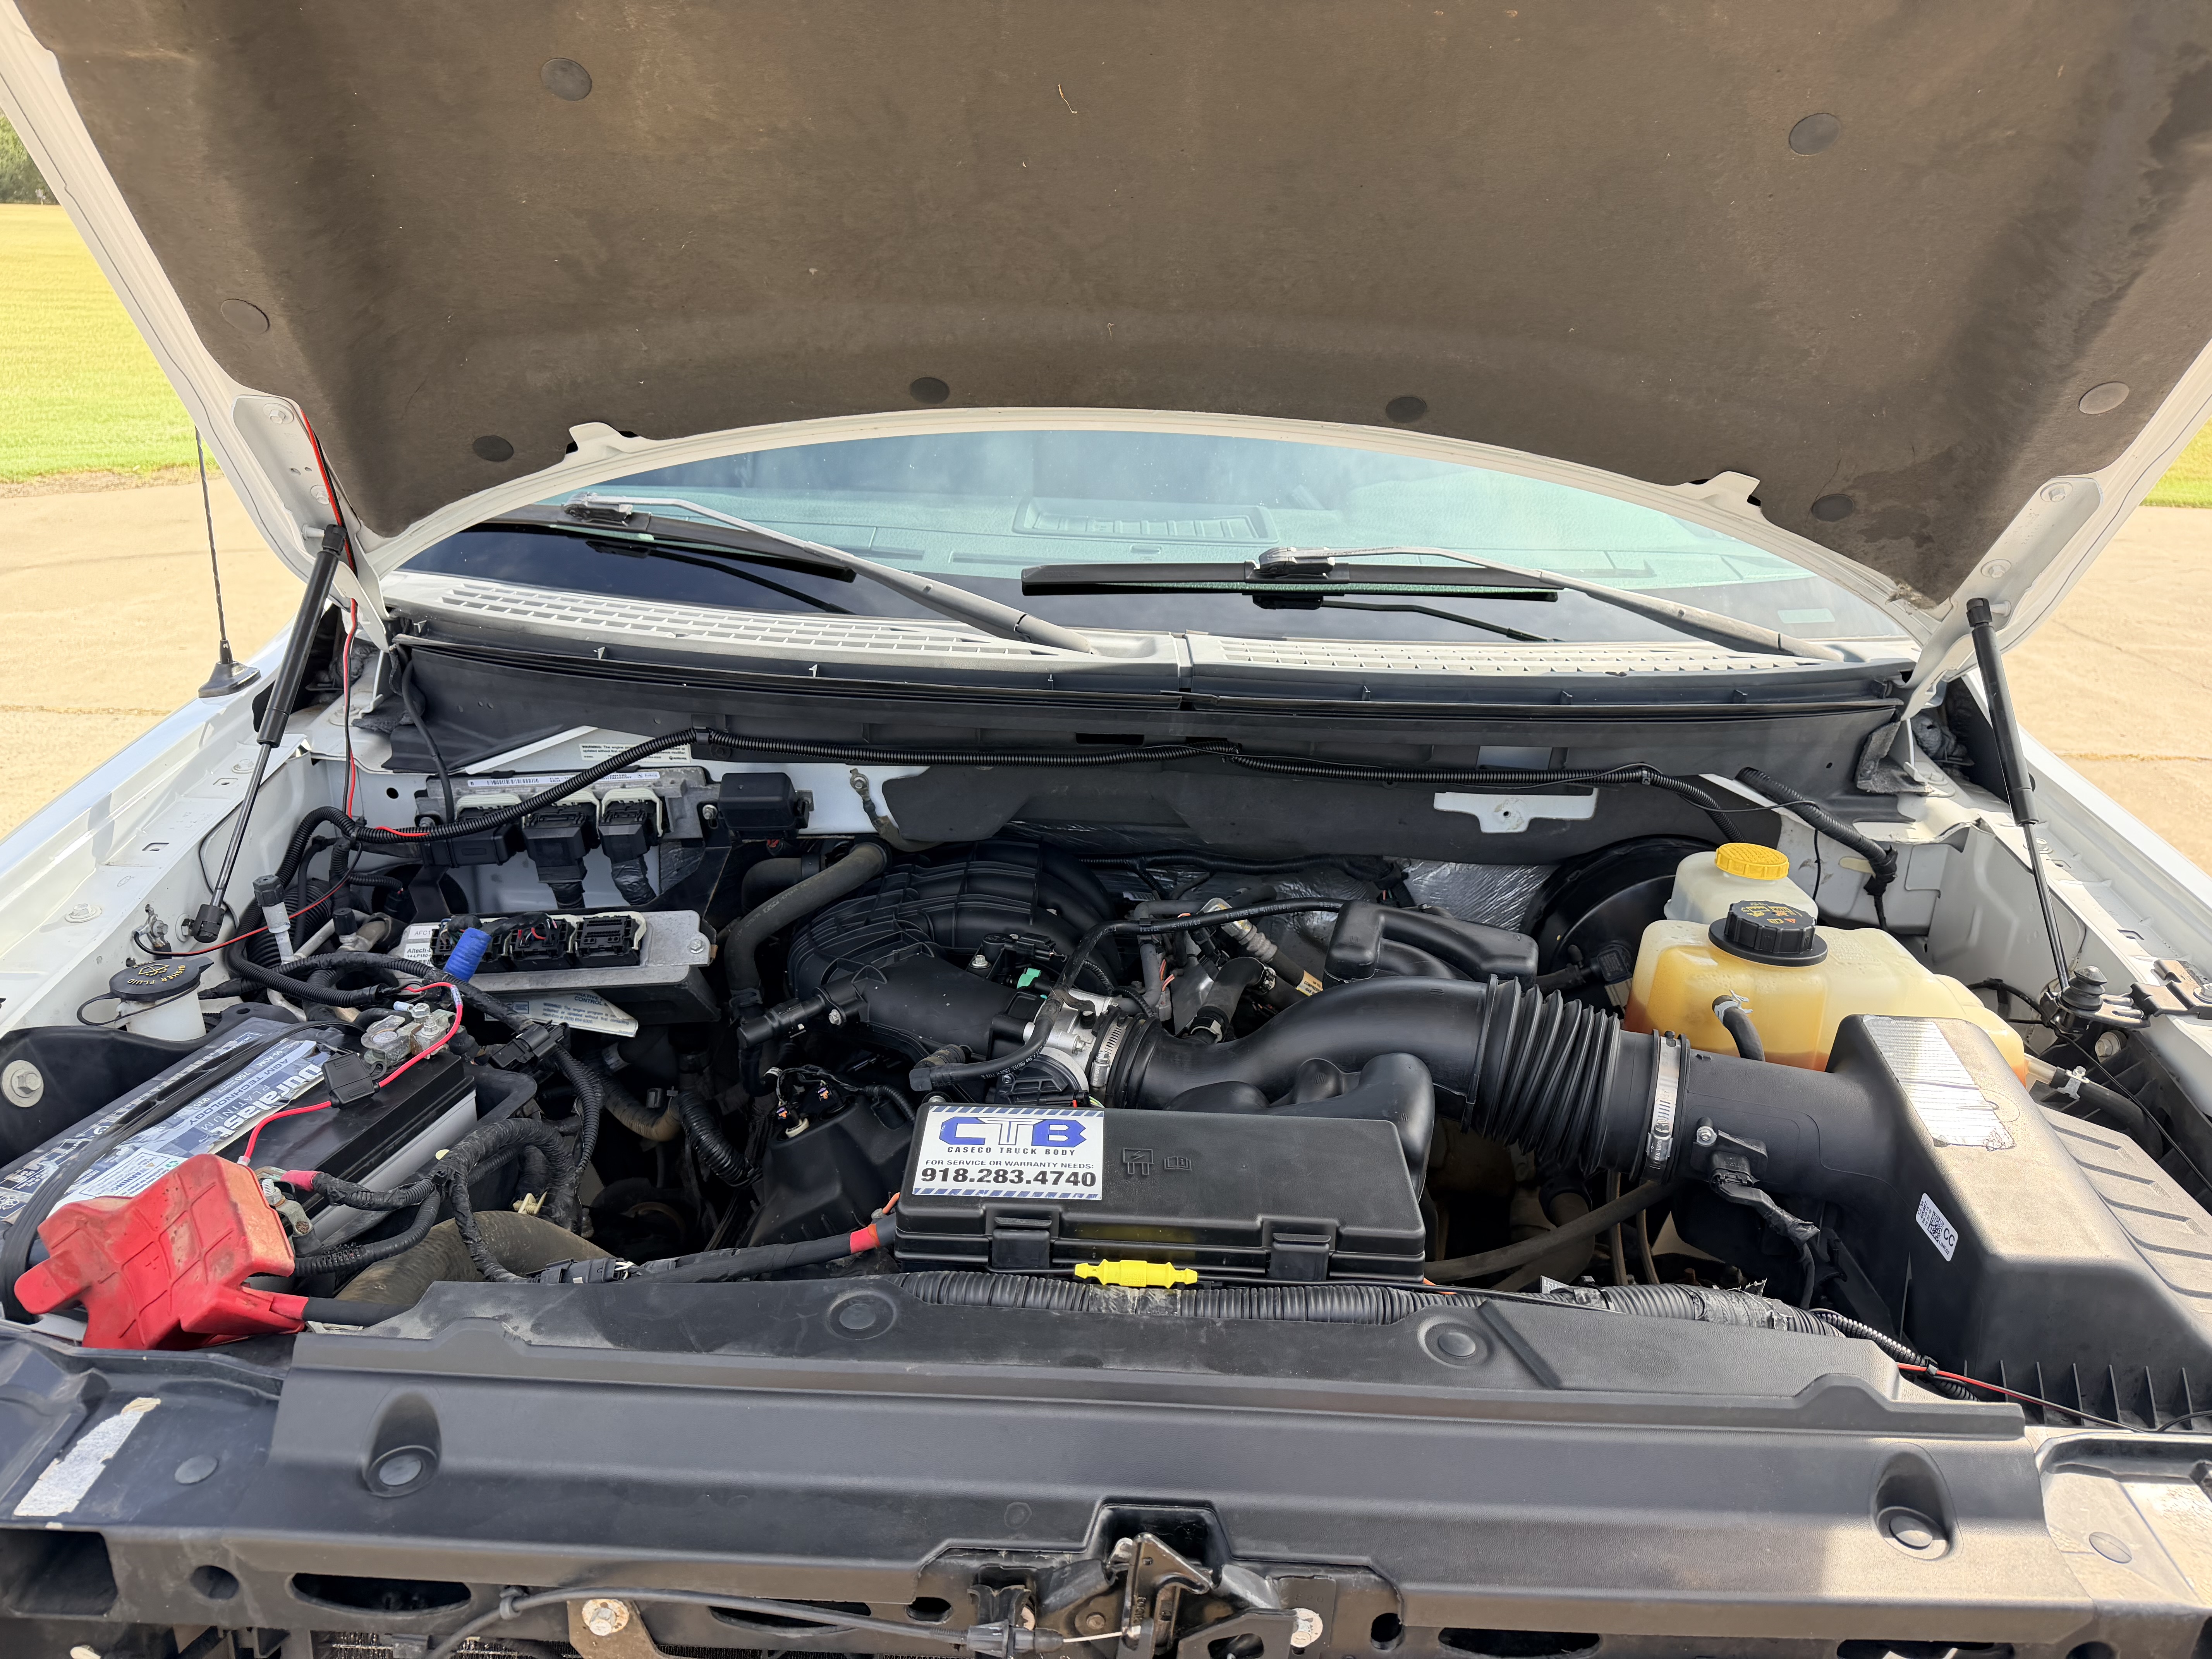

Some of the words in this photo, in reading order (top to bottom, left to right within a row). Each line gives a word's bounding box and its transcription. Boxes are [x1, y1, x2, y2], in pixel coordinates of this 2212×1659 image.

[161, 965, 186, 982] WASHER
[235, 1071, 251, 1081] 750
[264, 1058, 288, 1075] AGM
[190, 1076, 264, 1126] TECHNOLOGY
[194, 1097, 210, 1108] 935
[201, 1085, 270, 1131] PLATINUM
[210, 1064, 323, 1137] Duralast
[939, 1116, 1087, 1148] CTB
[999, 1147, 1037, 1155] TRUCK
[1045, 1148, 1076, 1156] BODY
[921, 1167, 1096, 1187] 918.283.4740
[1943, 1228, 1955, 1247] CC
